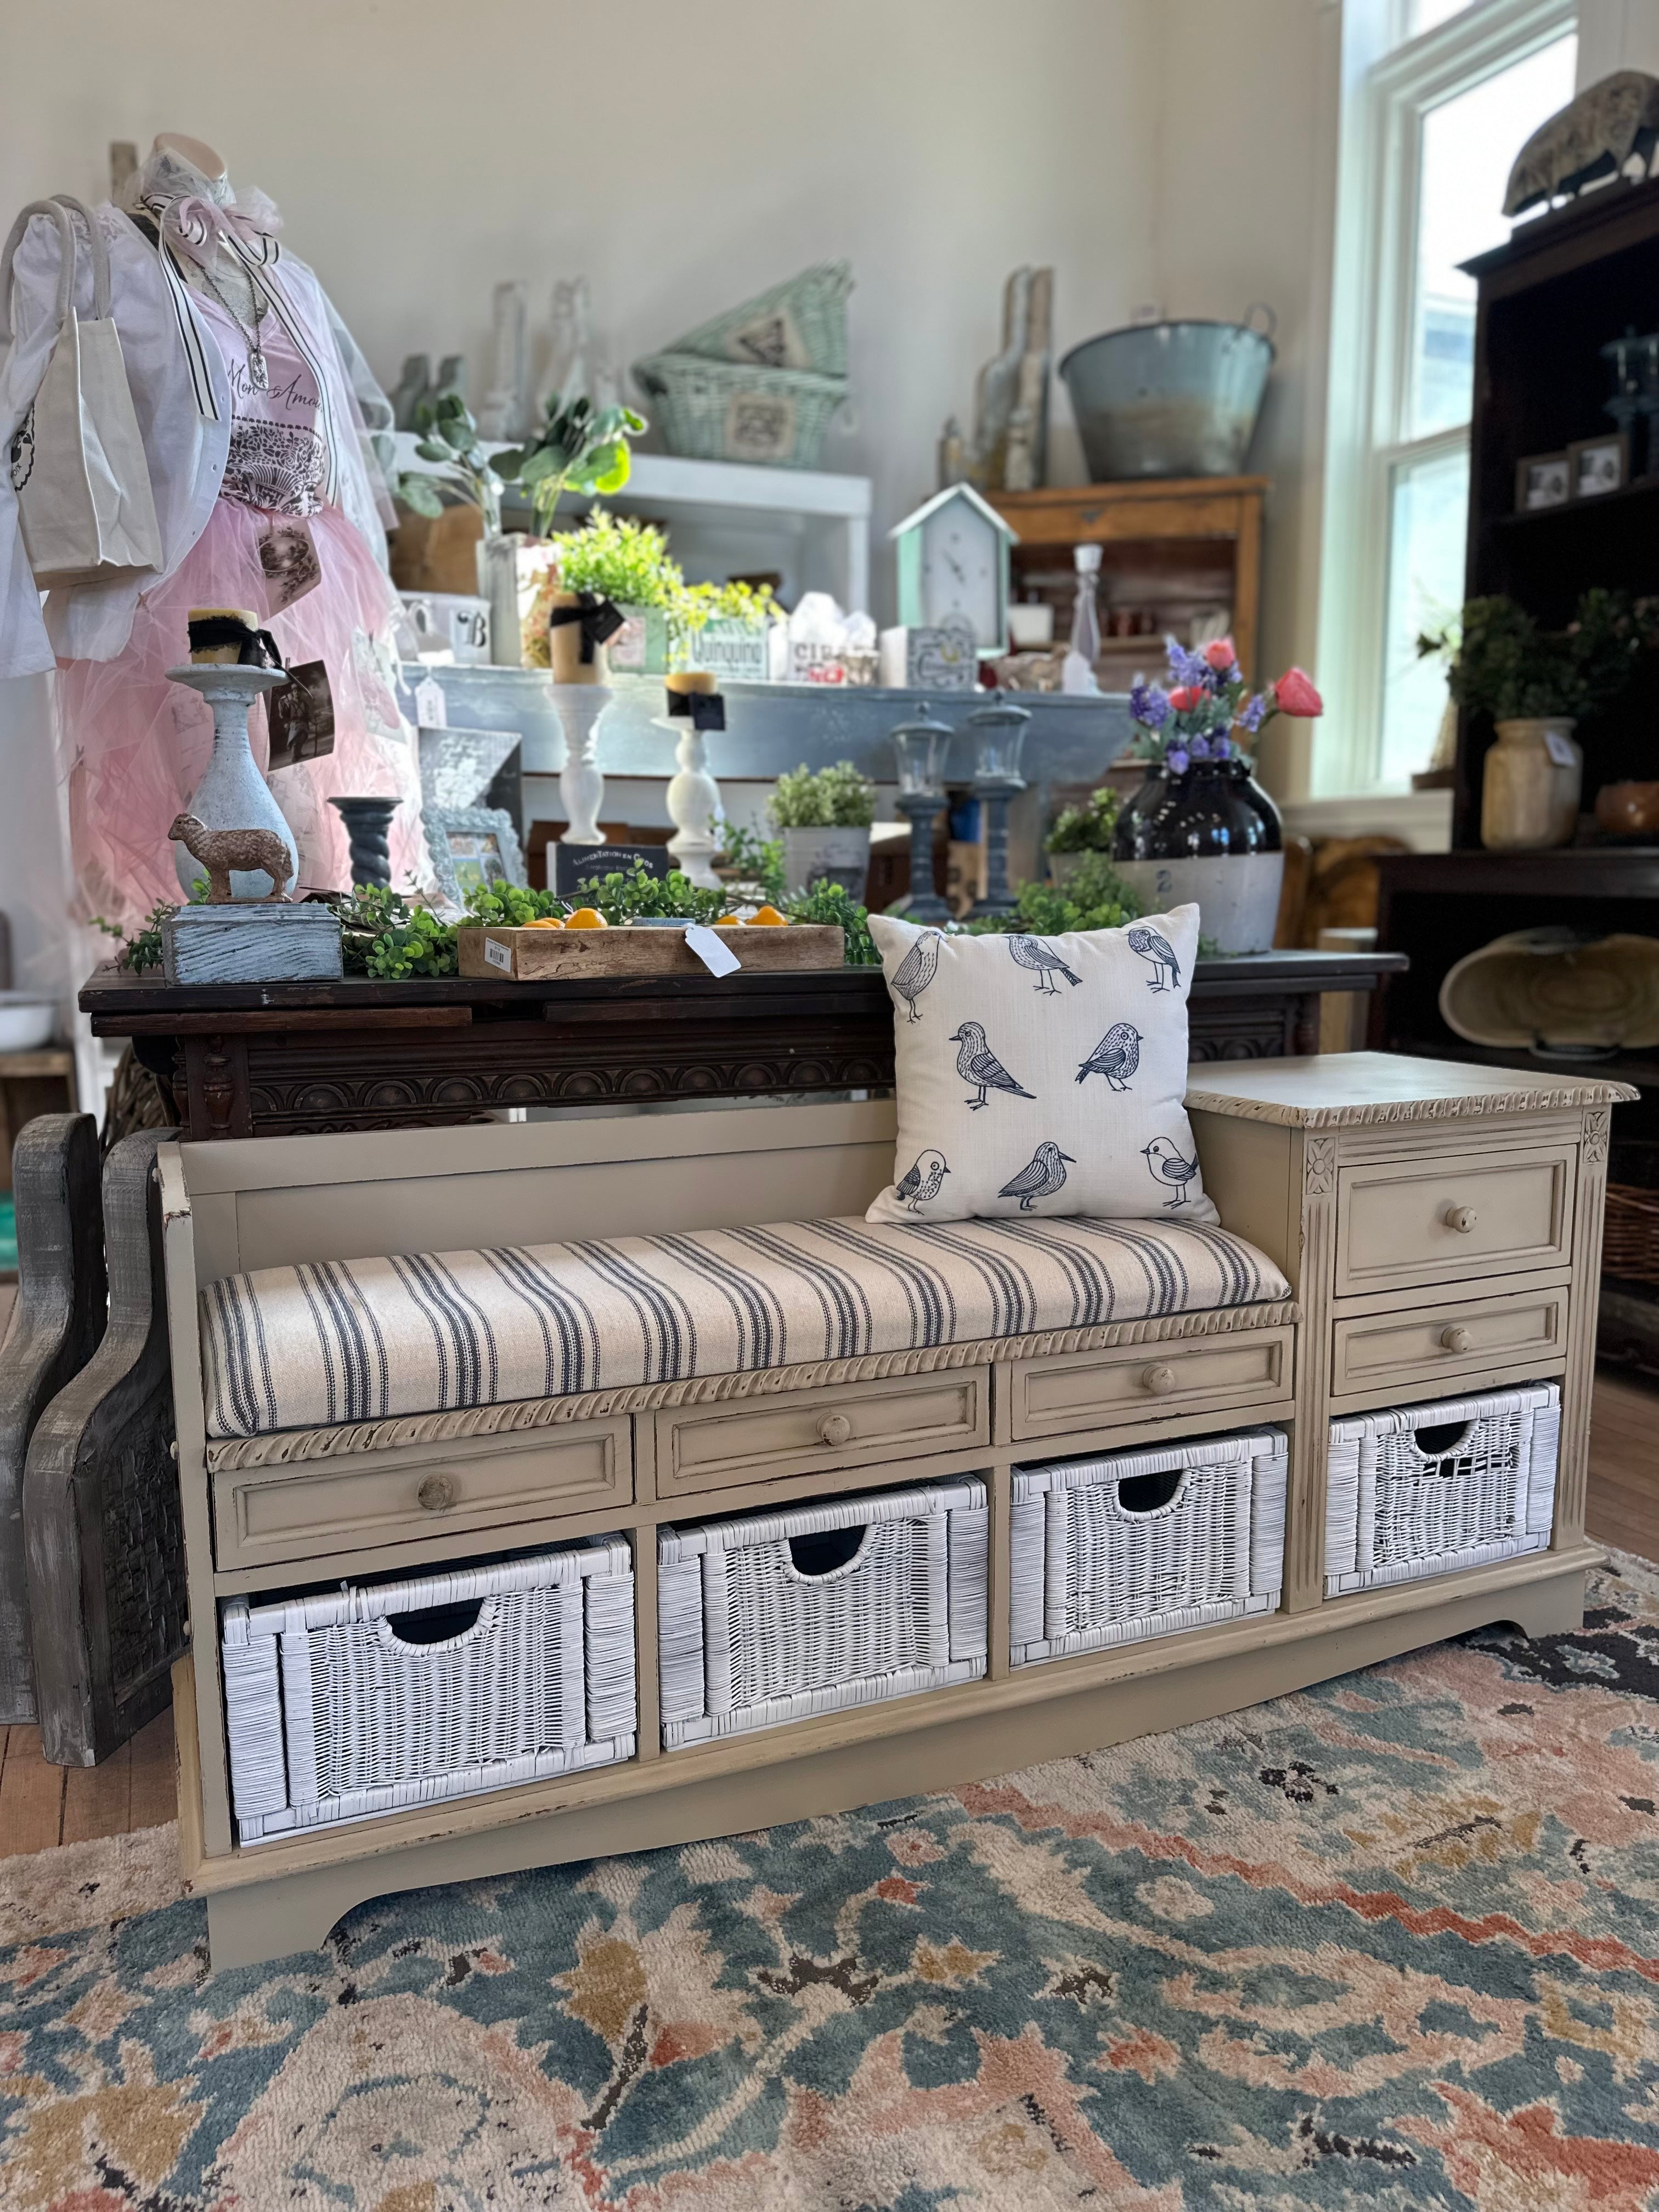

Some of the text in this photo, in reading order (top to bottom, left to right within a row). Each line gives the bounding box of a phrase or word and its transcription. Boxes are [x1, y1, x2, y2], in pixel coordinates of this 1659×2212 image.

[228, 358, 258, 399] Mon
[573, 850, 622, 866] ALIMENTATION
[633, 853, 654, 869] GOS
[1156, 870, 1172, 893] 2
